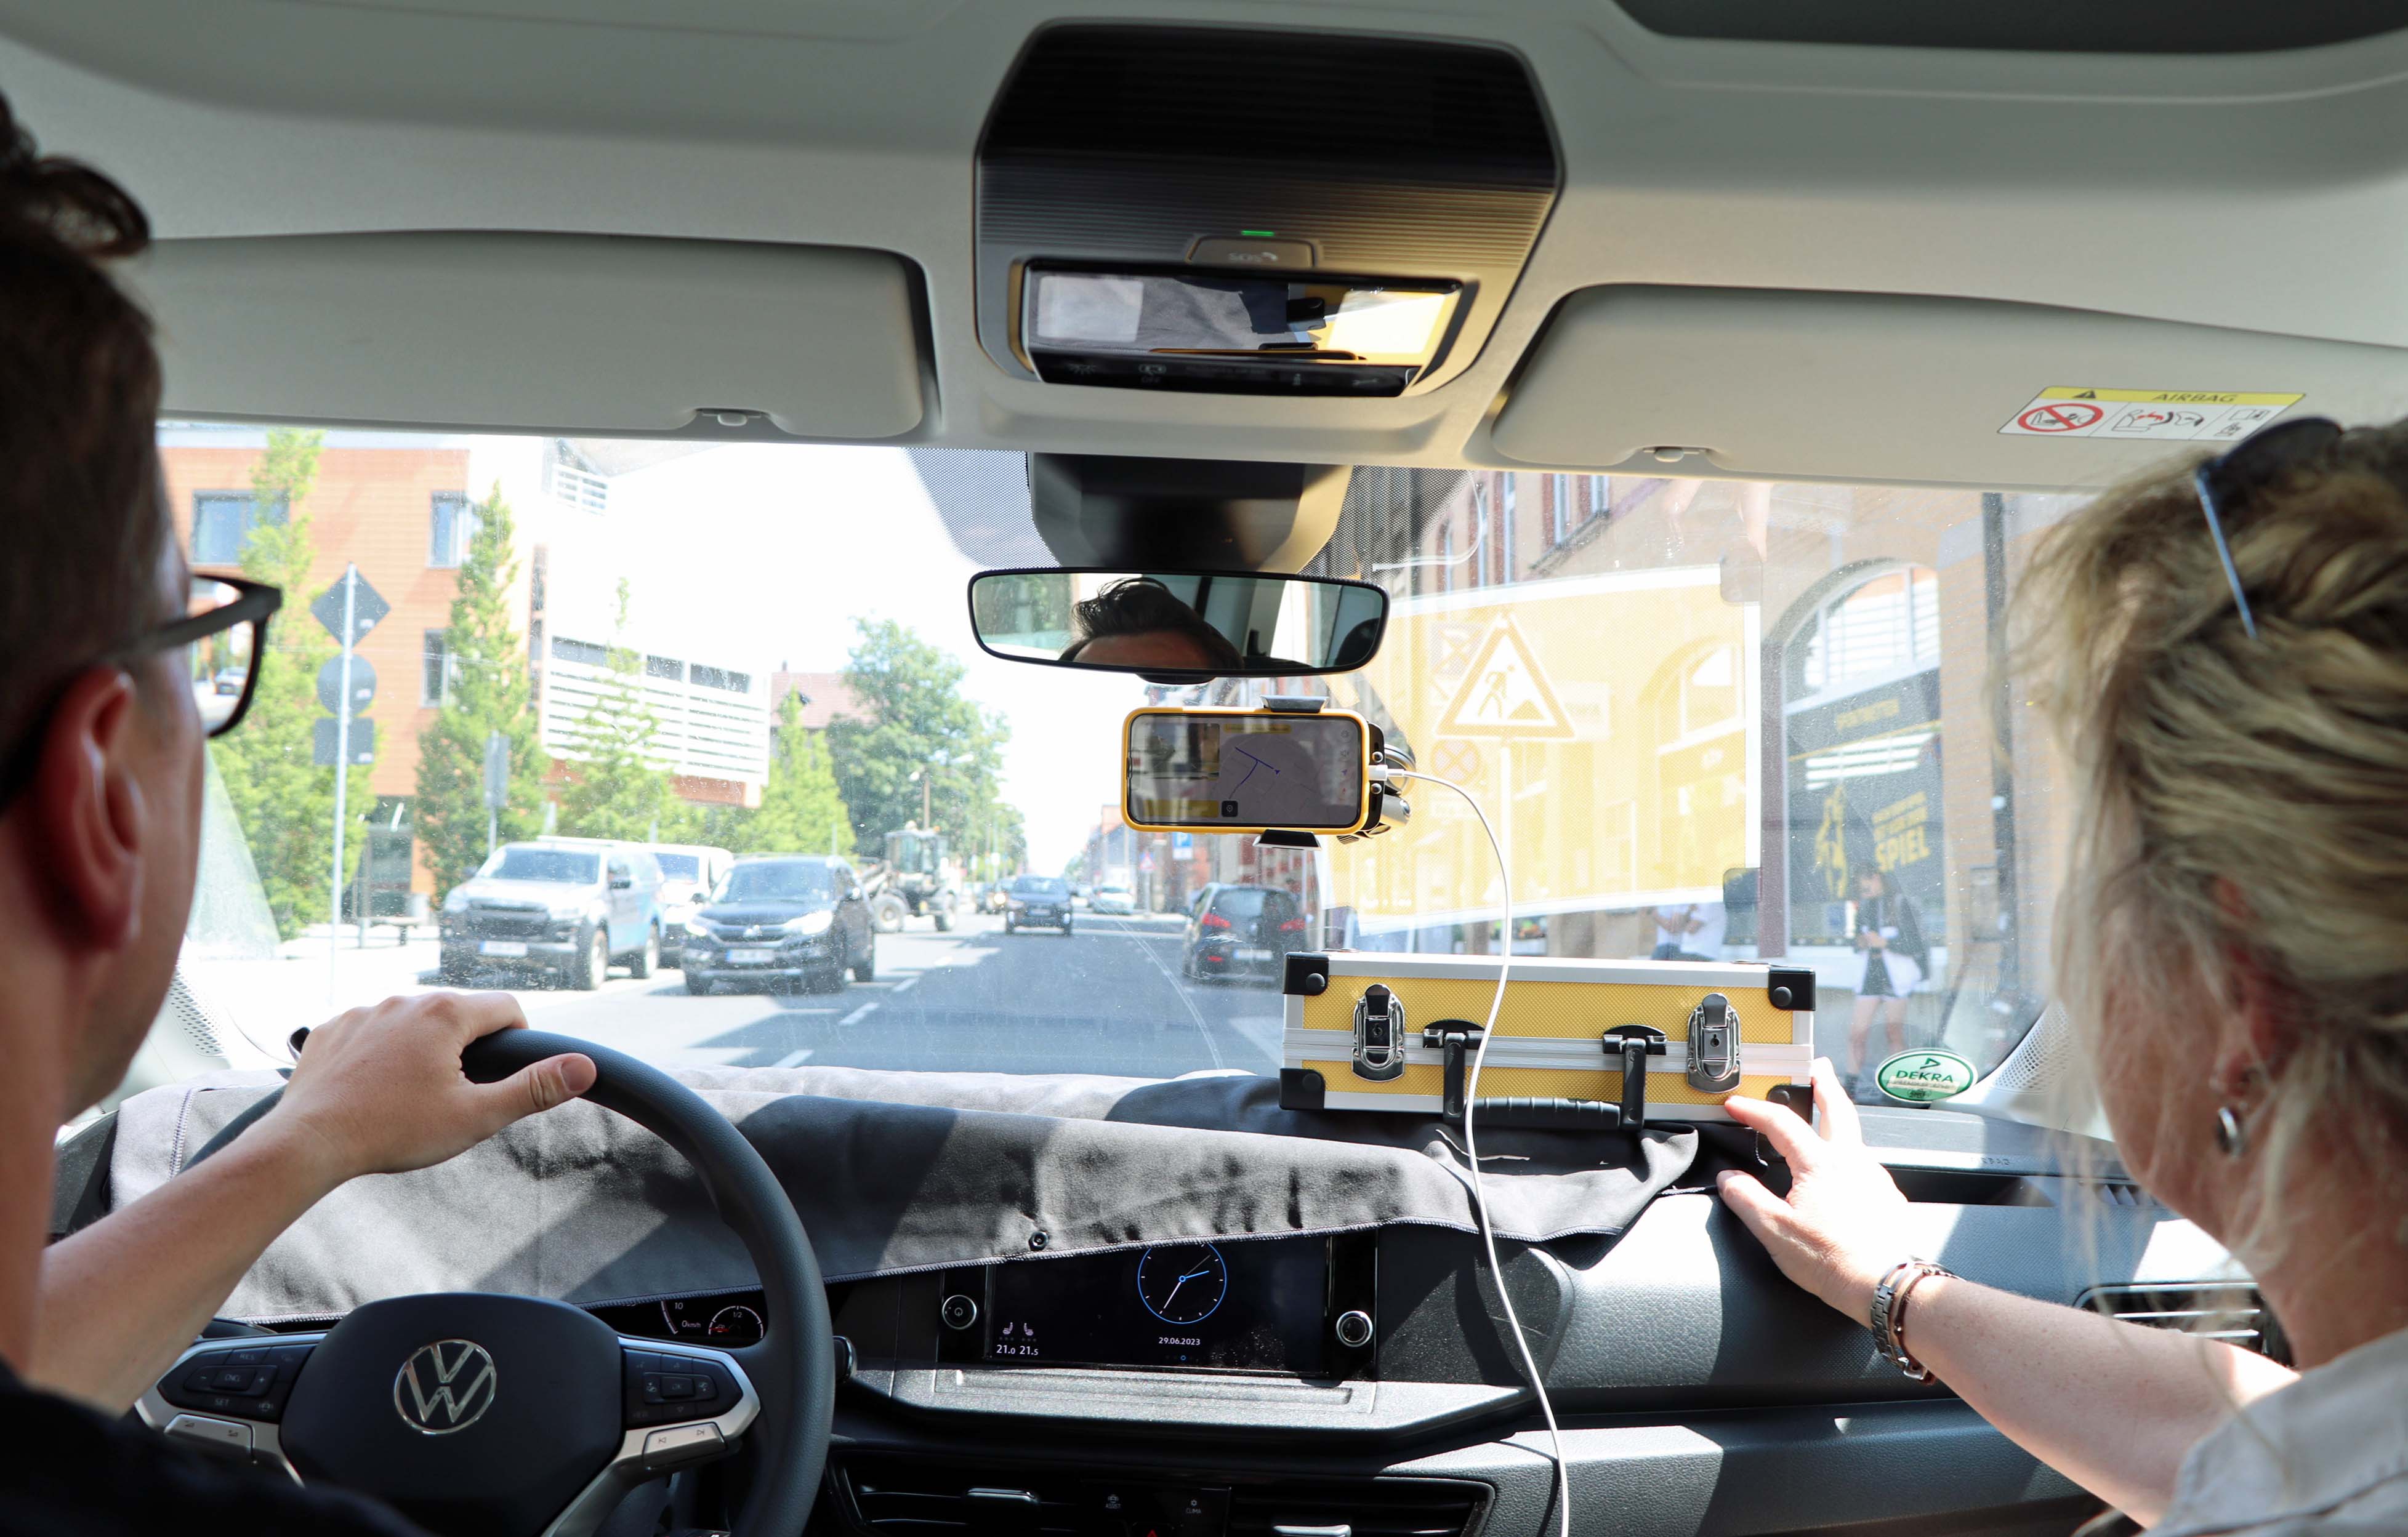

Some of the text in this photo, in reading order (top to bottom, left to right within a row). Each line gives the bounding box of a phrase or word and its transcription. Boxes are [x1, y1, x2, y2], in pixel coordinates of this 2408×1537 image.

[1228, 252, 1262, 262] SOS
[2151, 393, 2237, 403] AIRBAG
[1875, 827, 1930, 872] SPIEL
[1896, 1070, 1953, 1082] DEKRA
[1158, 1337, 1201, 1346] 29.06.2023
[996, 1344, 1039, 1355] 21.0 21.5
[402, 1341, 495, 1424] VW
